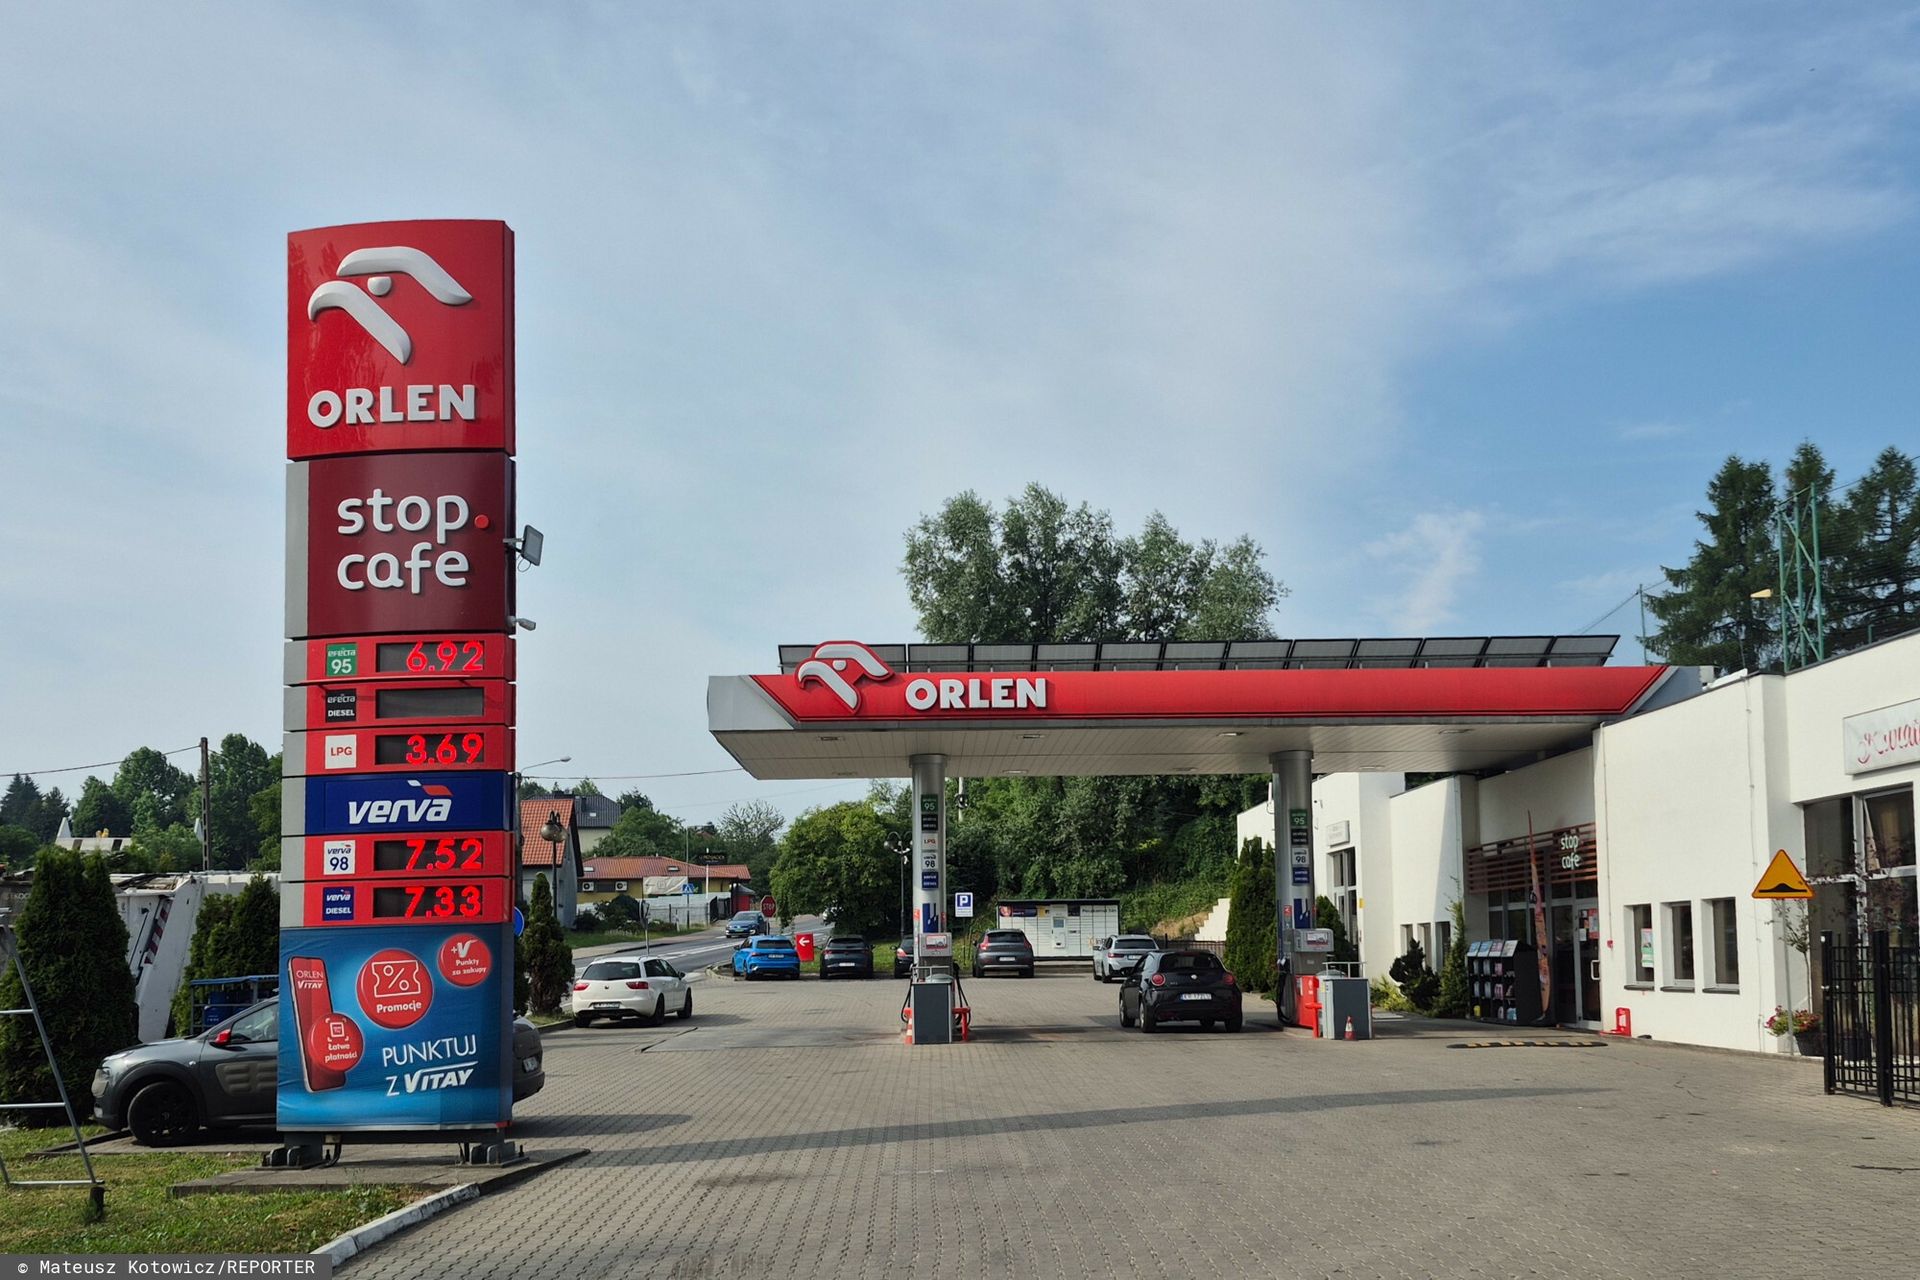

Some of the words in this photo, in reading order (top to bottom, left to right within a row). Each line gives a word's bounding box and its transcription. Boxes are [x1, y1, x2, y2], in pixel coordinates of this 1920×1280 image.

[307, 384, 475, 428] ORLEN
[337, 542, 469, 594] cafe
[406, 640, 484, 672] 6.92
[331, 659, 352, 674] 95
[905, 677, 1047, 710] ORLEN
[328, 709, 355, 718] DIESEL
[331, 746, 352, 757] LPG
[406, 733, 484, 765] 3.69
[348, 798, 452, 825] verva
[924, 802, 936, 810] 95
[1294, 816, 1305, 825] 95
[1560, 832, 1579, 852] stop
[327, 847, 352, 855] verva
[405, 838, 483, 871] 7.52
[330, 856, 349, 871] 98
[925, 860, 936, 868] 98
[1296, 855, 1306, 864] 98
[1561, 852, 1581, 870] cafe
[326, 894, 351, 902] verva
[404, 886, 482, 918] 7.33
[959, 895, 969, 907] P
[325, 907, 352, 915] DIESEL
[763, 902, 775, 911] STOP
[455, 959, 479, 967] Punkty
[296, 970, 324, 979] ORLEN
[463, 966, 487, 975] zakupy
[376, 1000, 422, 1014] Promocje
[324, 1051, 358, 1063] płatności
[382, 1034, 477, 1067] PUNKTUJ
[385, 1076, 400, 1097] Z
